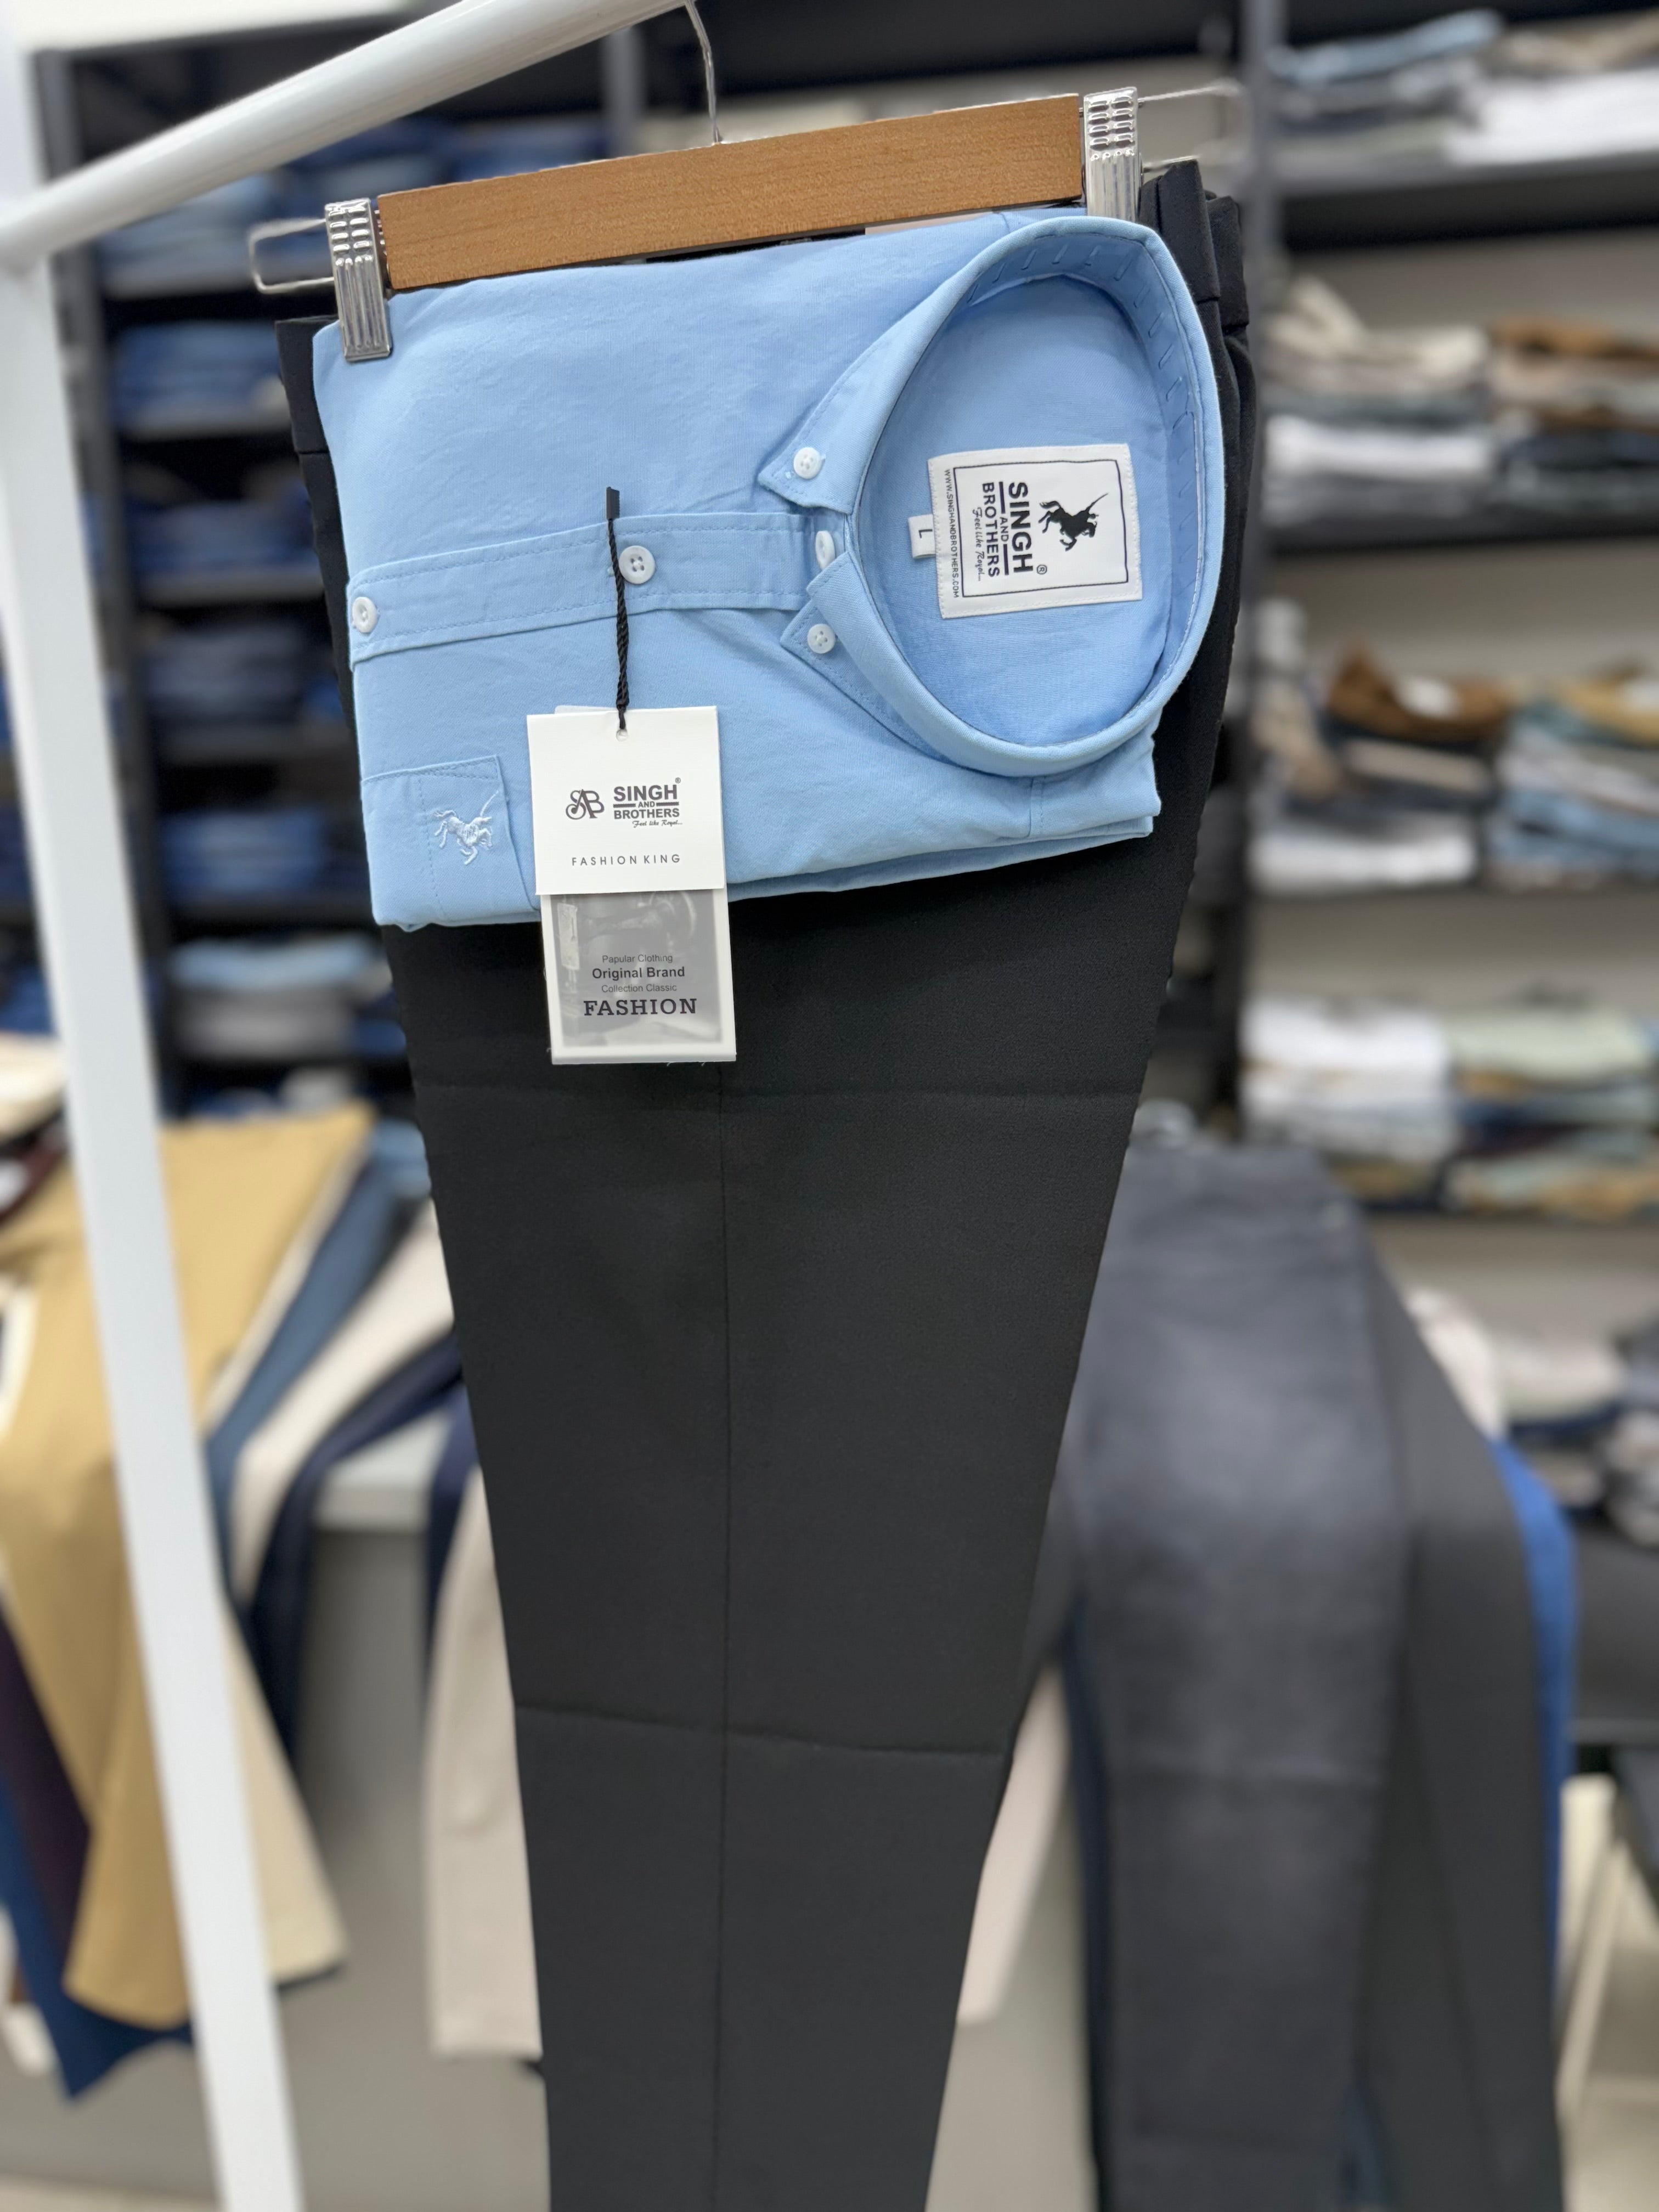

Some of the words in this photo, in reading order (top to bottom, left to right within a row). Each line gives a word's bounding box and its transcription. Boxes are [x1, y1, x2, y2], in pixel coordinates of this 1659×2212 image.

[918, 528, 933, 539] L
[944, 470, 960, 598] WWW.SINGHANDBROTHERS.COM
[982, 482, 1000, 578] BROTHERS
[1000, 516, 1009, 543] AND
[1008, 482, 1034, 574] SINGH
[613, 785, 678, 802] SINGH
[614, 808, 680, 820] BROTHERS
[572, 855, 637, 866] FASHION
[644, 854, 680, 864] KING
[602, 955, 635, 964] Papular
[637, 953, 673, 963] Clothing
[591, 967, 642, 981] Original
[646, 966, 685, 978] Brand
[601, 984, 644, 993] Collection
[646, 984, 677, 992] Classic
[583, 998, 697, 1016] FASHION
